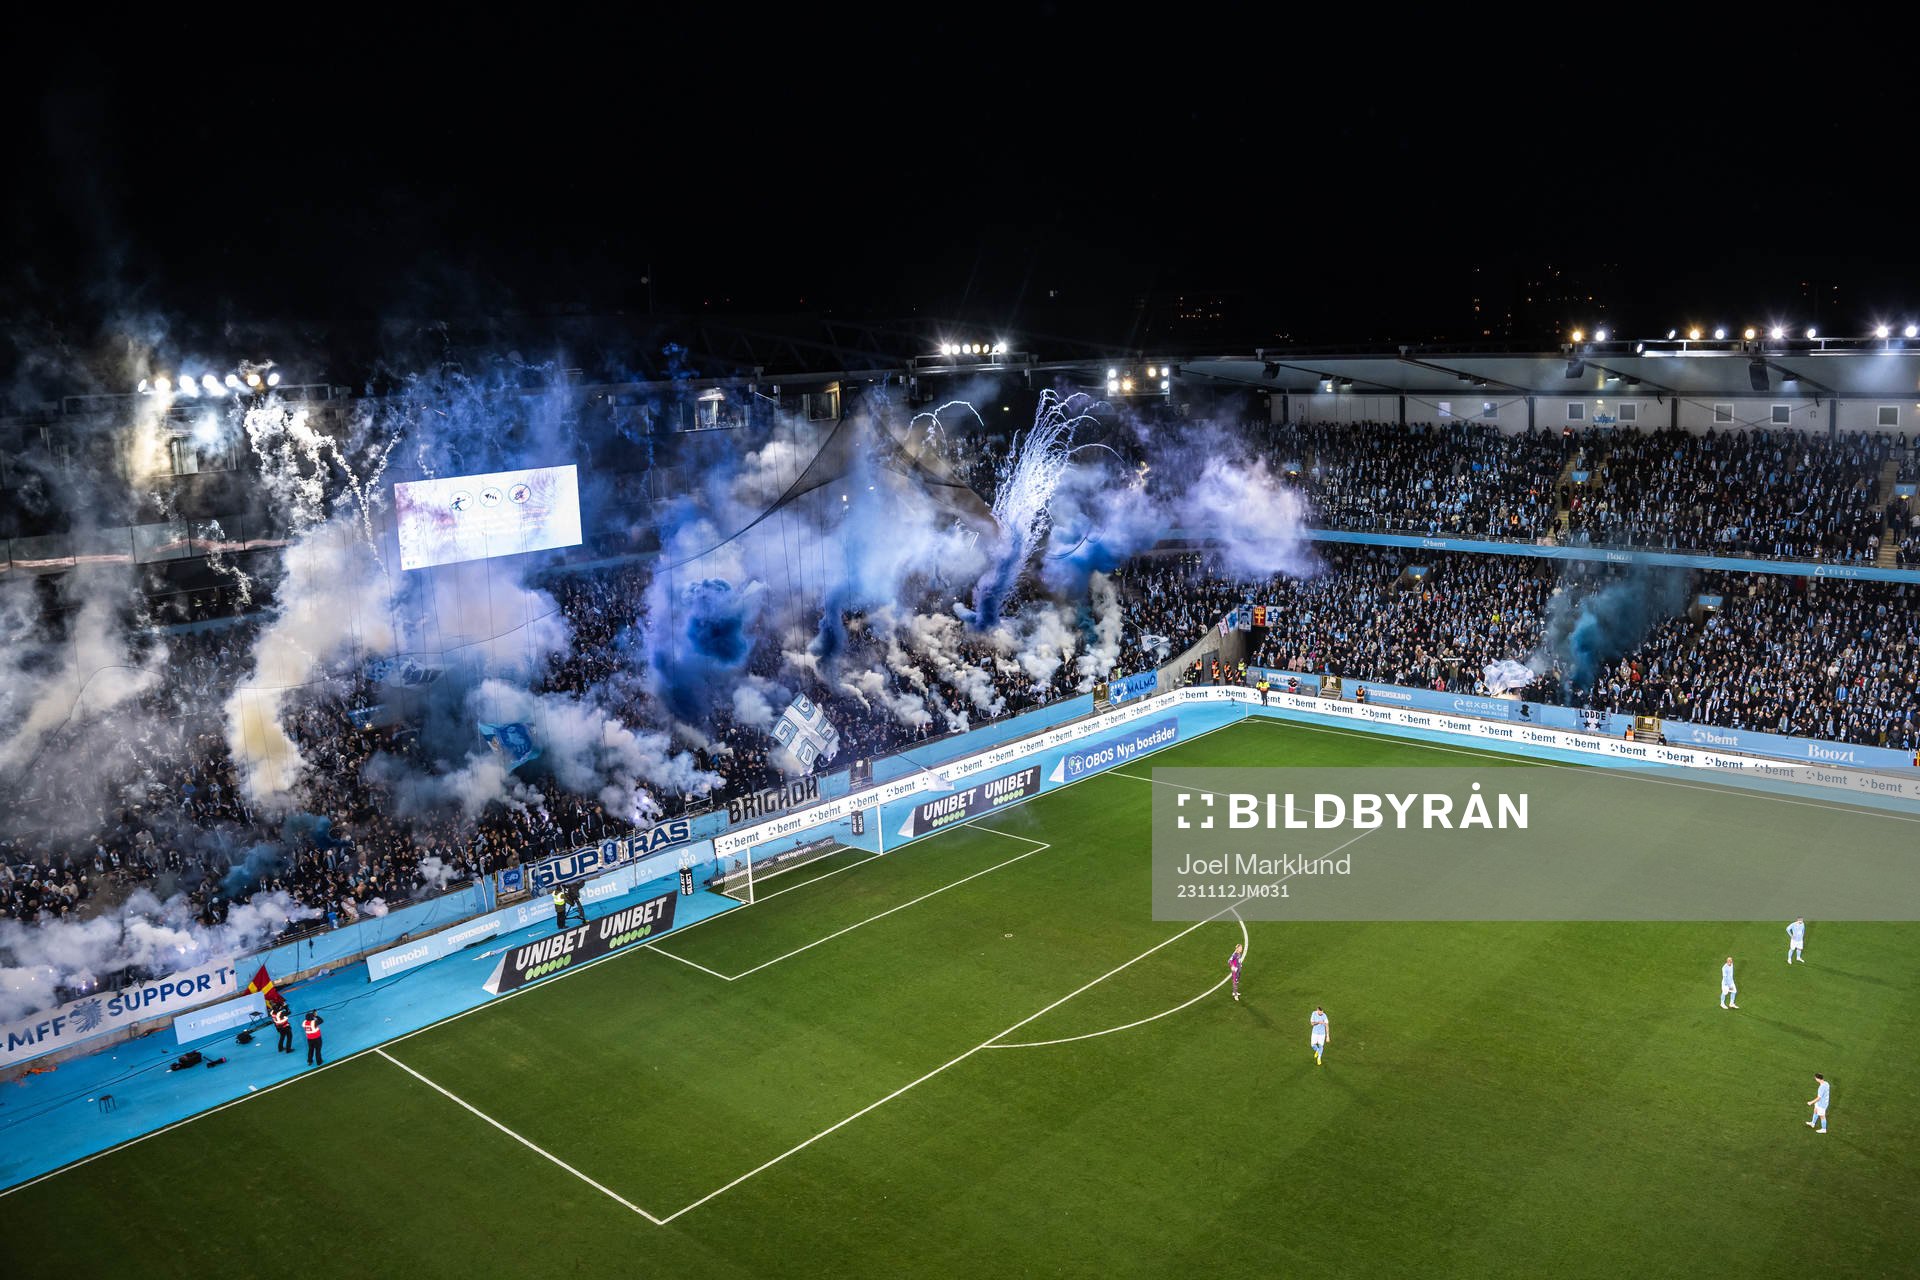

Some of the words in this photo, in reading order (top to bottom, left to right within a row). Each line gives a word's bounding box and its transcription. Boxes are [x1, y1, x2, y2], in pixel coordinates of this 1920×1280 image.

[1085, 748, 1114, 769] OBOS
[1117, 742, 1135, 757] Nya
[1136, 727, 1176, 751] bostäder
[1225, 689, 1246, 698] bemt
[1267, 695, 1280, 704] emt
[1296, 698, 1316, 709] bemt
[1331, 703, 1353, 715] bemt
[1369, 708, 1391, 720] bemt
[1407, 714, 1430, 726] bemt
[1447, 719, 1471, 731] bemt
[1488, 725, 1513, 737] bemt
[1531, 732, 1556, 744] bemt
[1575, 738, 1600, 750] bemt
[1620, 744, 1646, 757] bemt
[1667, 750, 1694, 763] bemt
[1715, 758, 1743, 770] bemt
[1765, 764, 1795, 777] bemt
[1817, 772, 1847, 785] bemt
[1871, 779, 1902, 793] bemt
[1706, 732, 1738, 746] bemt
[1808, 743, 1855, 762] Boozt
[734, 832, 759, 847] bemt
[777, 819, 801, 833] bemt
[818, 806, 841, 820] bemt
[856, 792, 879, 808] bemt
[894, 781, 915, 795] bemt
[963, 759, 983, 773] bemt
[995, 749, 1014, 762] bemt
[1026, 739, 1044, 751] bemt
[1055, 730, 1073, 742] bemt
[1083, 721, 1100, 732] bemt
[1110, 712, 1126, 724] bemt
[1136, 704, 1151, 715] bemt
[1160, 696, 1175, 706] bemt
[1185, 691, 1208, 699] bemt
[923, 789, 977, 820] UNIBET
[984, 769, 1034, 799] UNIBET
[586, 881, 617, 898] bemt
[515, 925, 590, 971] UNIBET
[600, 896, 667, 939] UNIBET
[8, 1015, 67, 1052] MFF
[108, 966, 227, 1017] SUPPORT
